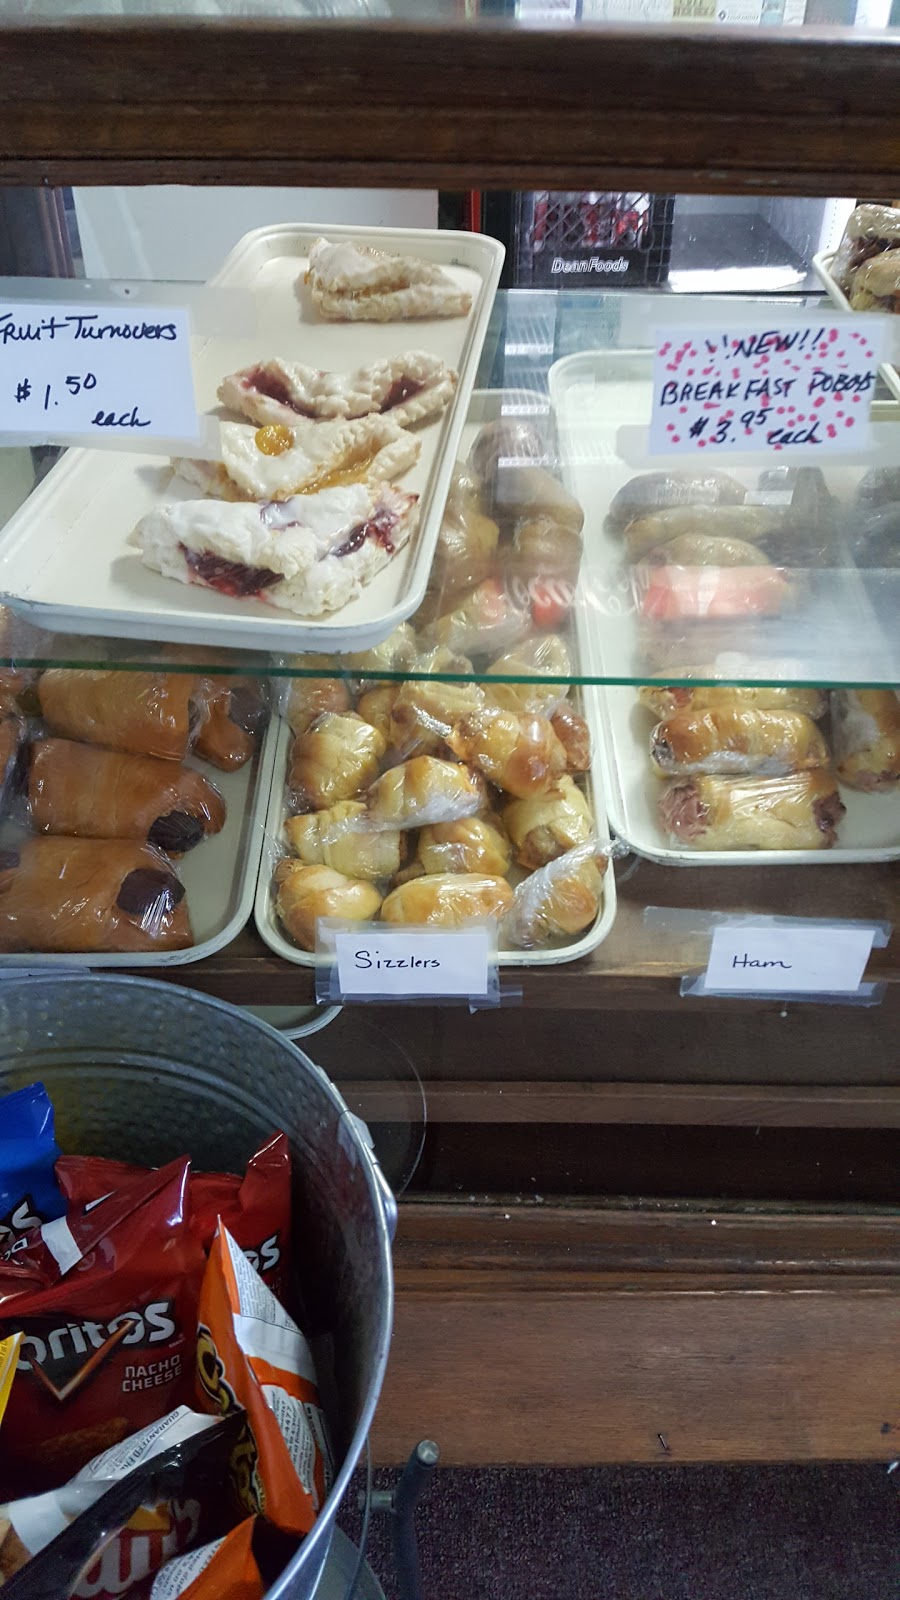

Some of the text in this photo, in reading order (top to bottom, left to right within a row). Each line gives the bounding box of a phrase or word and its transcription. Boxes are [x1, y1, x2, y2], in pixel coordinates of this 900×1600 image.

[65, 315, 177, 340] Turnovers
[91, 406, 152, 427] each
[767, 421, 822, 445] each
[354, 950, 441, 969] Sizzlers
[732, 953, 793, 969] Ham
[16, 1302, 176, 1372] oritos
[124, 1354, 181, 1377] NACHO
[121, 1365, 183, 1393] CHEESE
